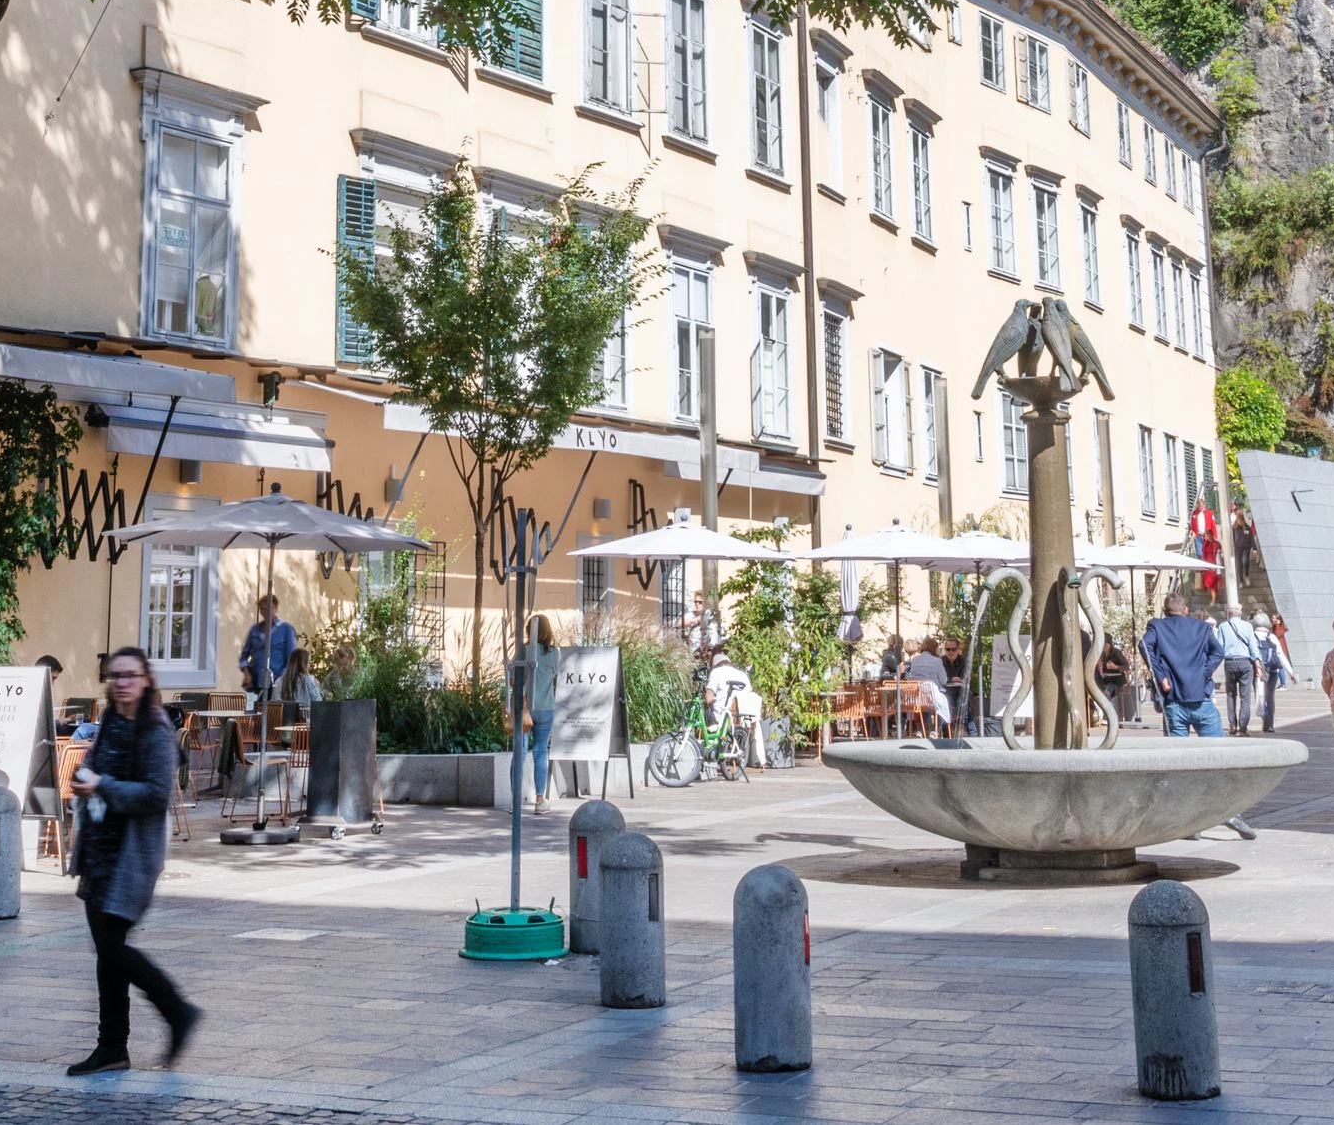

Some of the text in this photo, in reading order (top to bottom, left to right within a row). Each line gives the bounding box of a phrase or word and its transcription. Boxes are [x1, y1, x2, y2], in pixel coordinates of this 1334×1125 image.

[575, 427, 618, 449] KLYO
[999, 653, 1032, 663] KLO
[565, 672, 608, 685] KLYO
